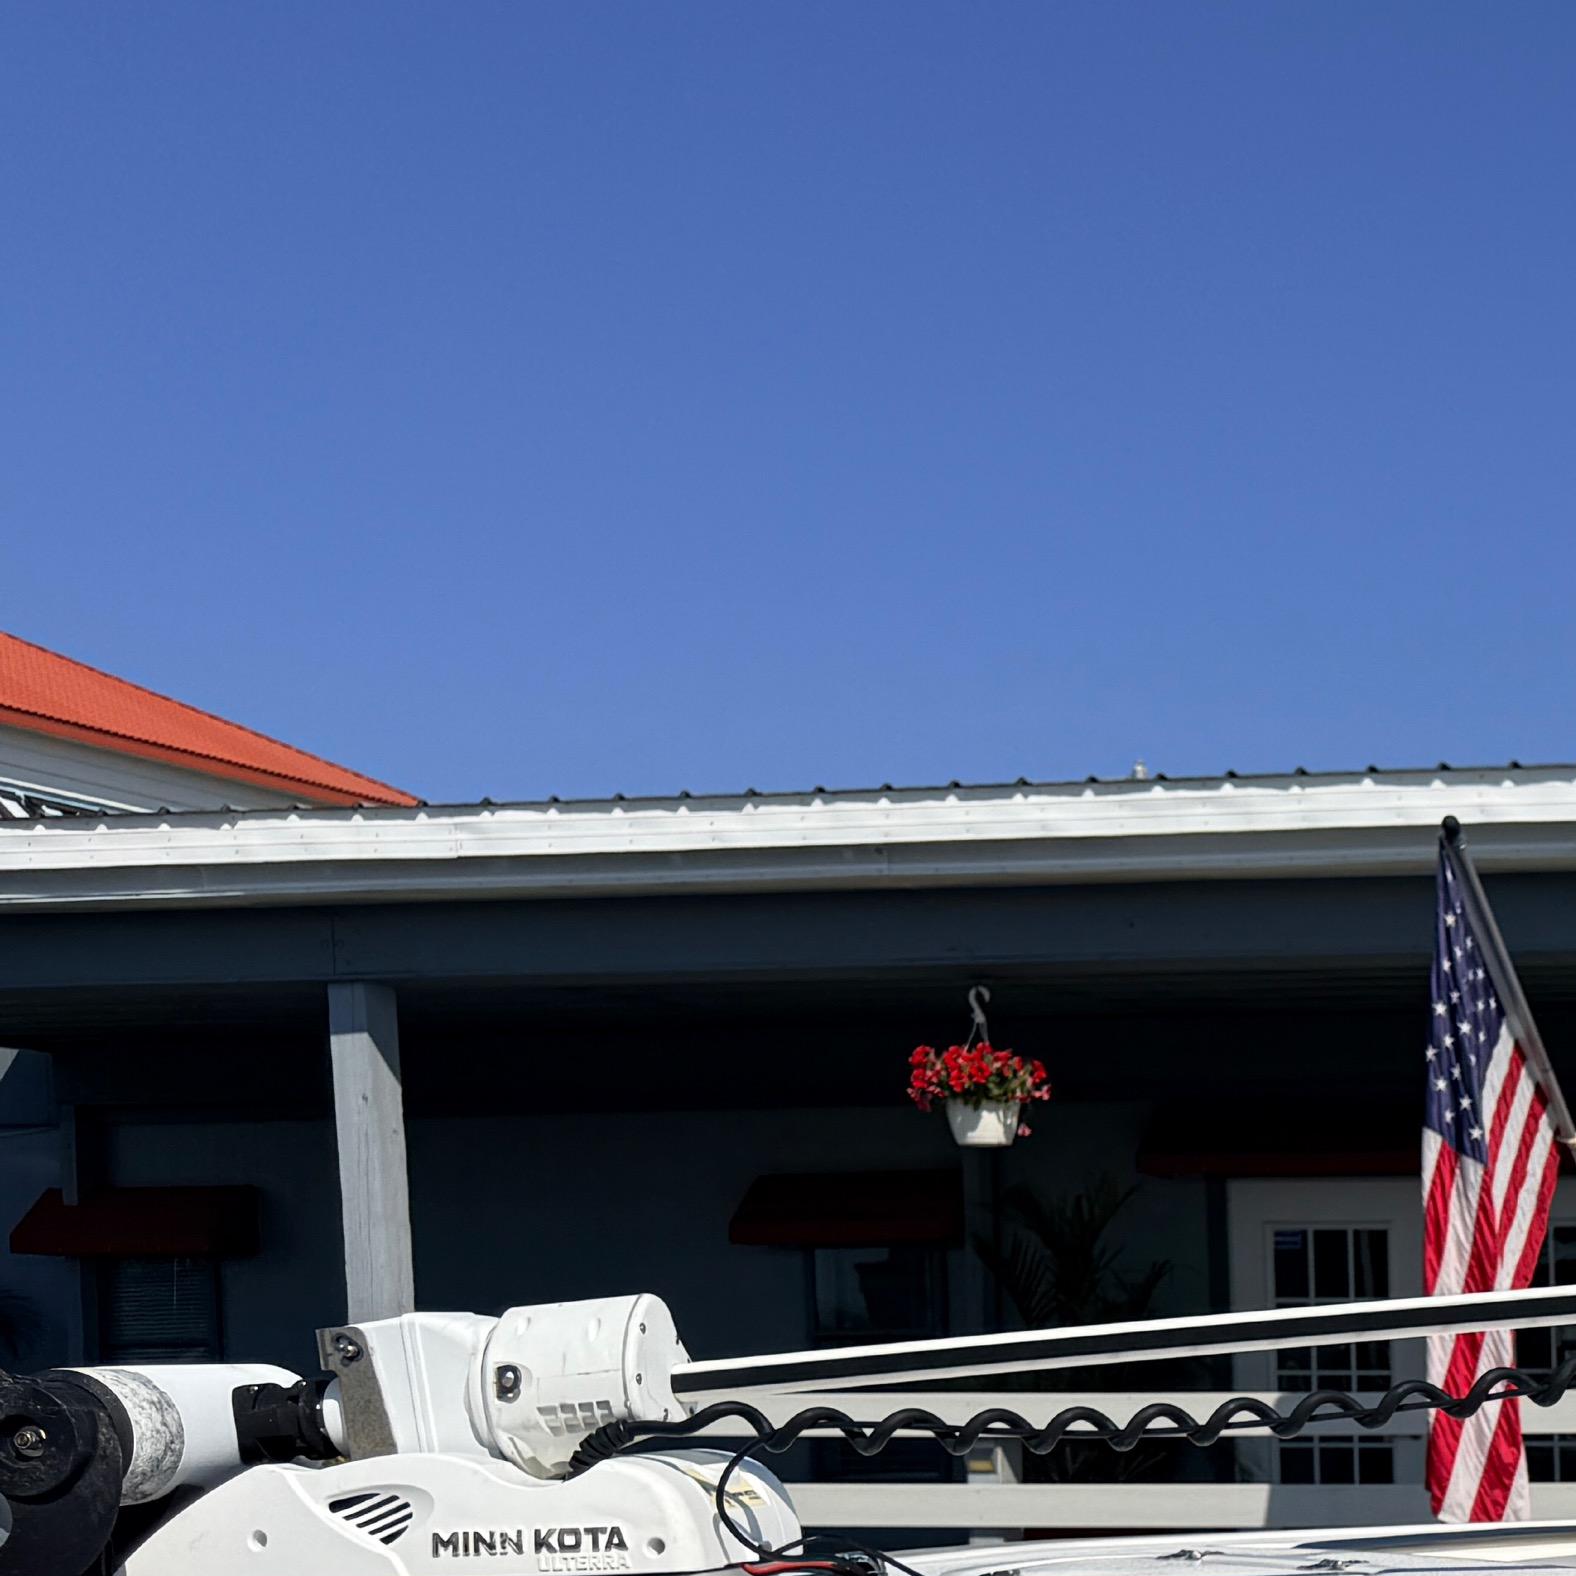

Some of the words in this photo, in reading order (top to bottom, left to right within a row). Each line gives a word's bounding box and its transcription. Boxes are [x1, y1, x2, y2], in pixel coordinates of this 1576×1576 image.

[432, 1529, 524, 1558] MINN
[533, 1526, 629, 1554] KOTA
[537, 1552, 631, 1572] ULTERRA
